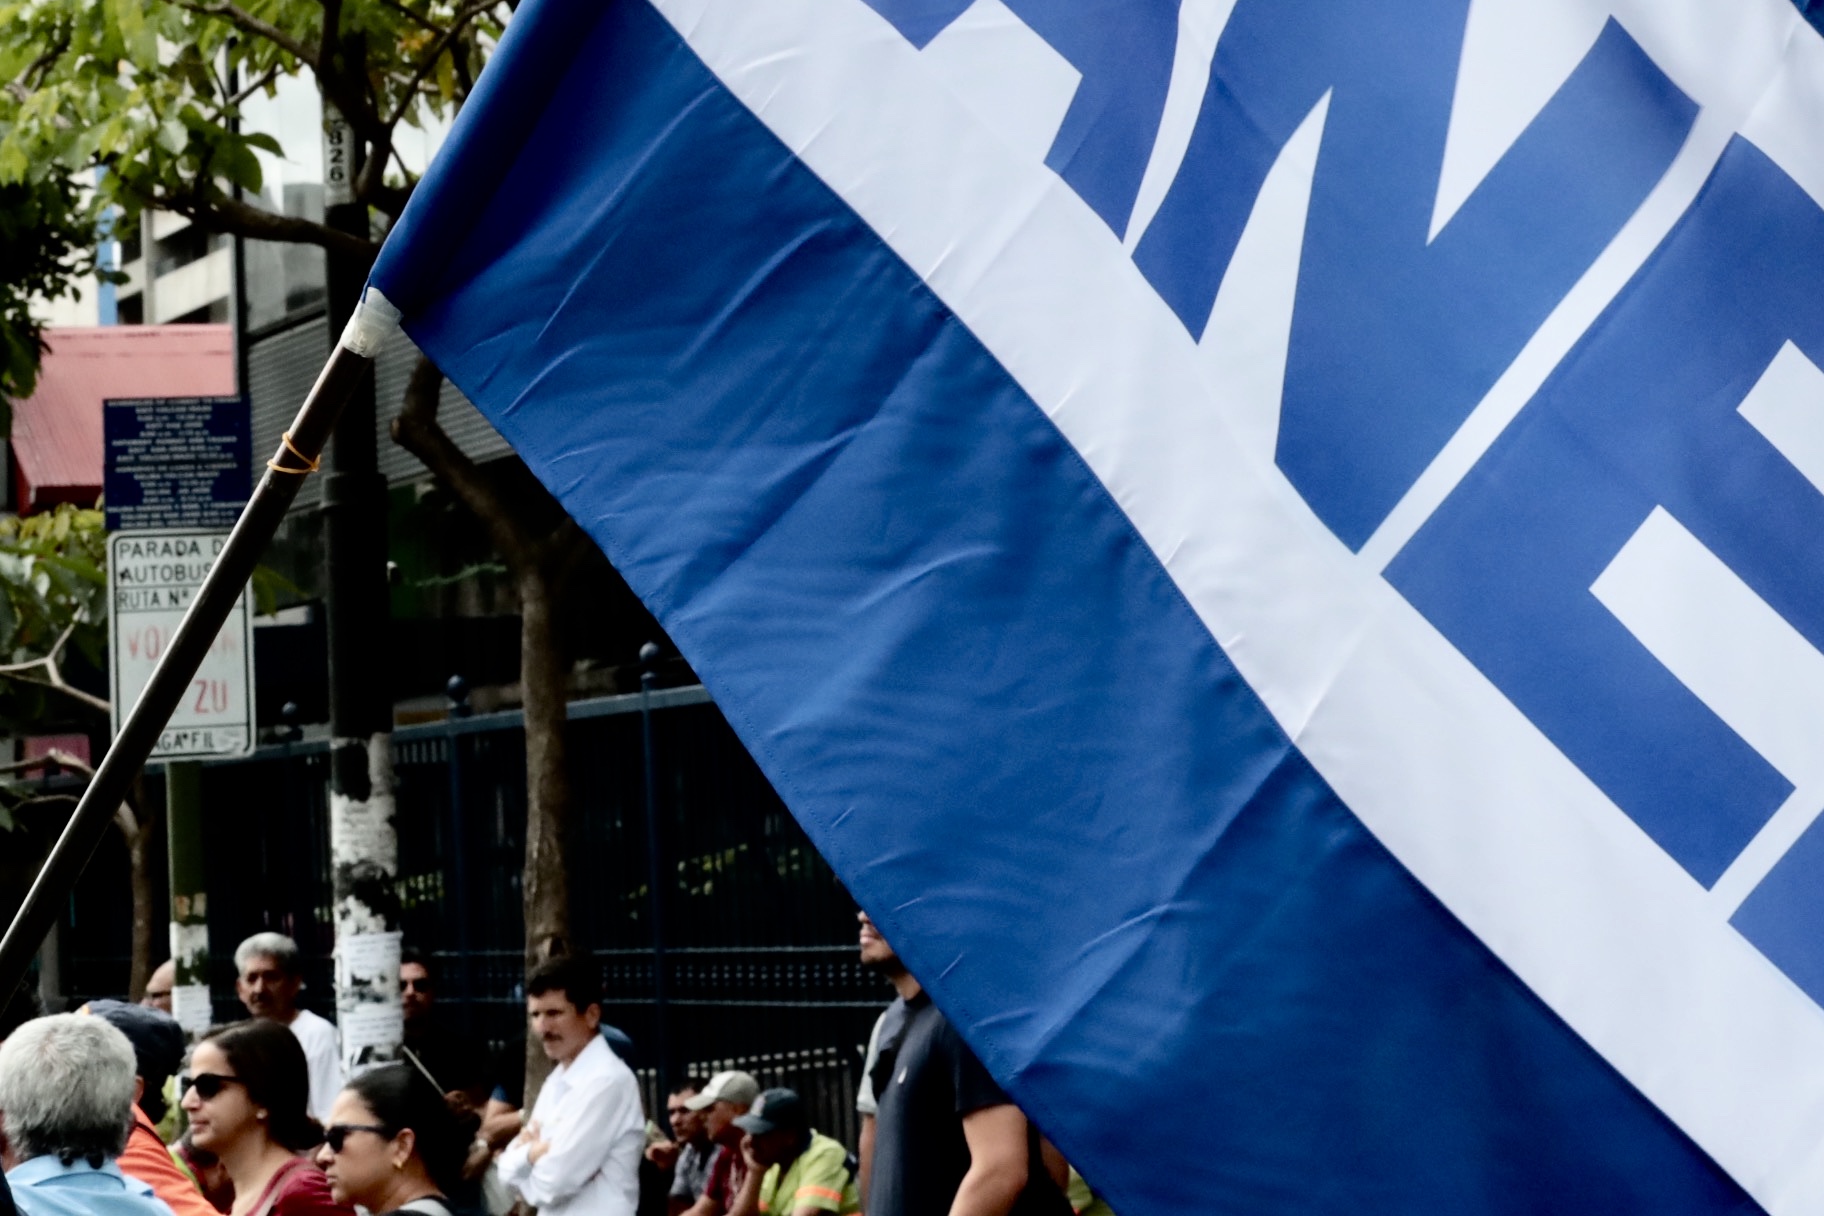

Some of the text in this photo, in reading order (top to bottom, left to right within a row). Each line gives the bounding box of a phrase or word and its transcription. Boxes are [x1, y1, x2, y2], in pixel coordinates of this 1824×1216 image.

[119, 540, 201, 559] PARADA
[119, 563, 214, 583] AUTOBUS
[119, 591, 160, 608] RUTA
